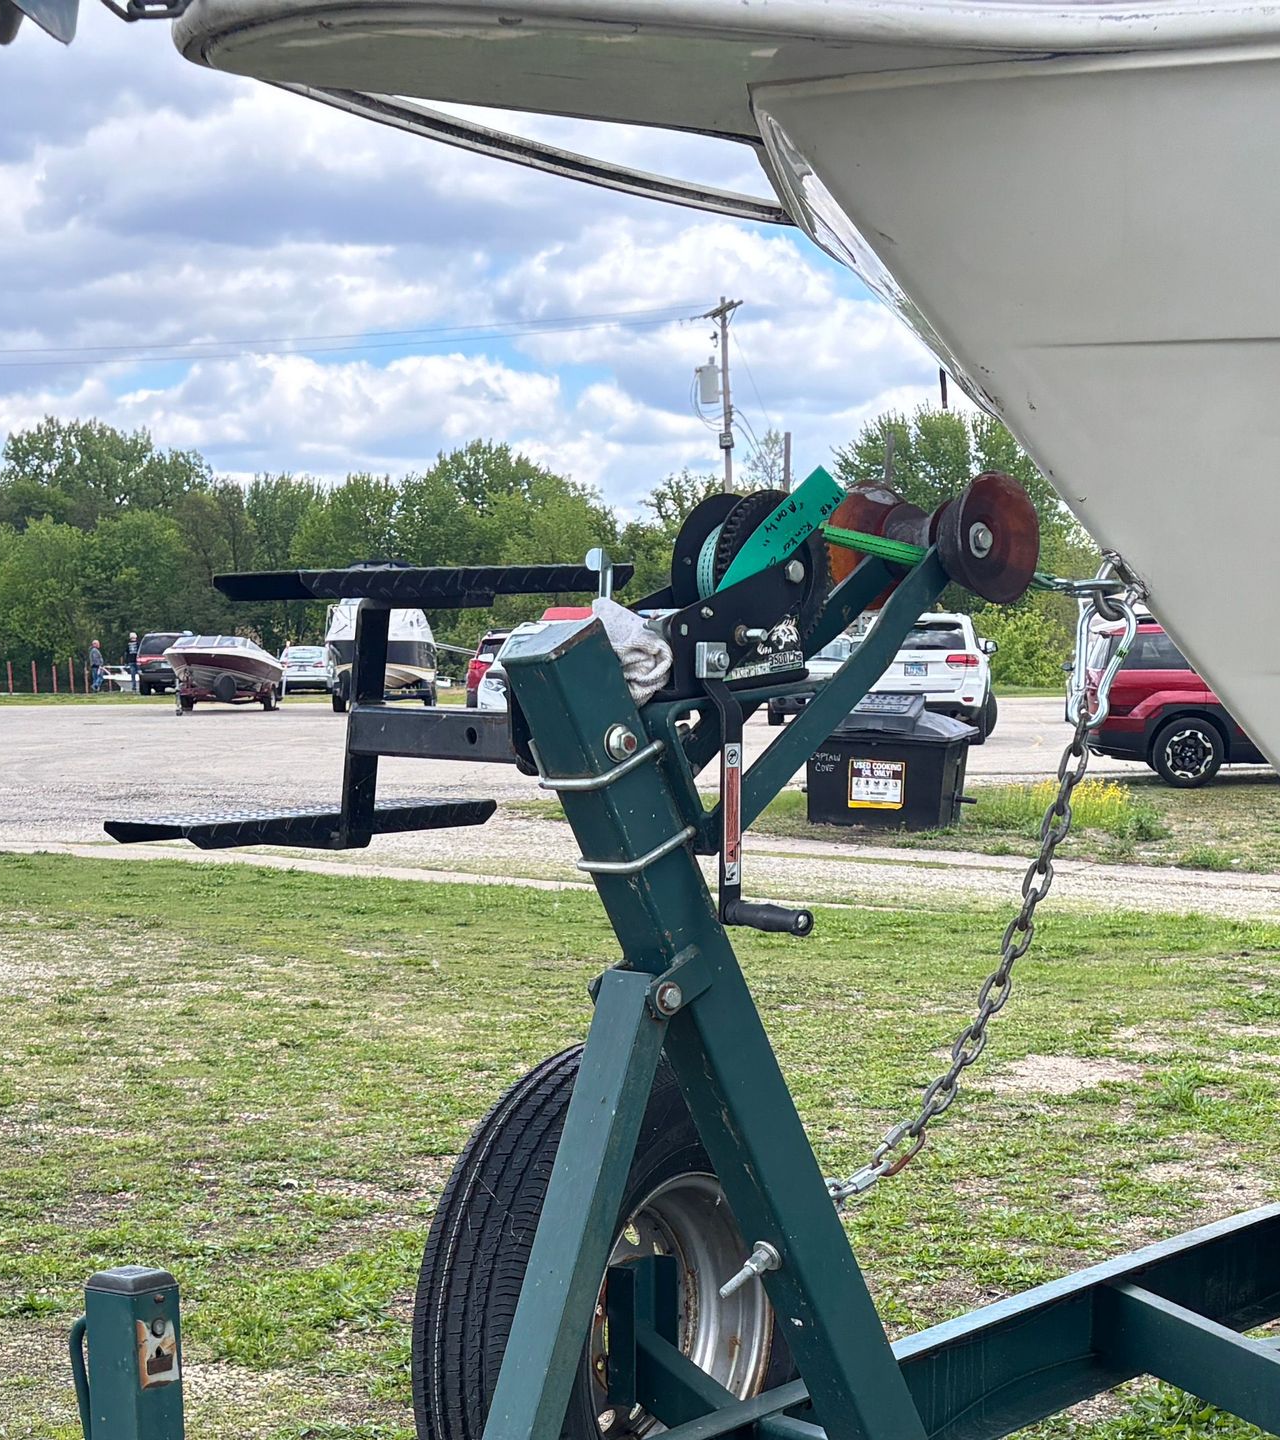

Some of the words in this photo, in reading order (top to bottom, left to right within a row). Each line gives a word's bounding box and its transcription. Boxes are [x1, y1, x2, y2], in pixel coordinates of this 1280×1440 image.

[853, 761, 872, 770] USED
[872, 763, 902, 771] COOKING
[861, 769, 872, 777] OIL
